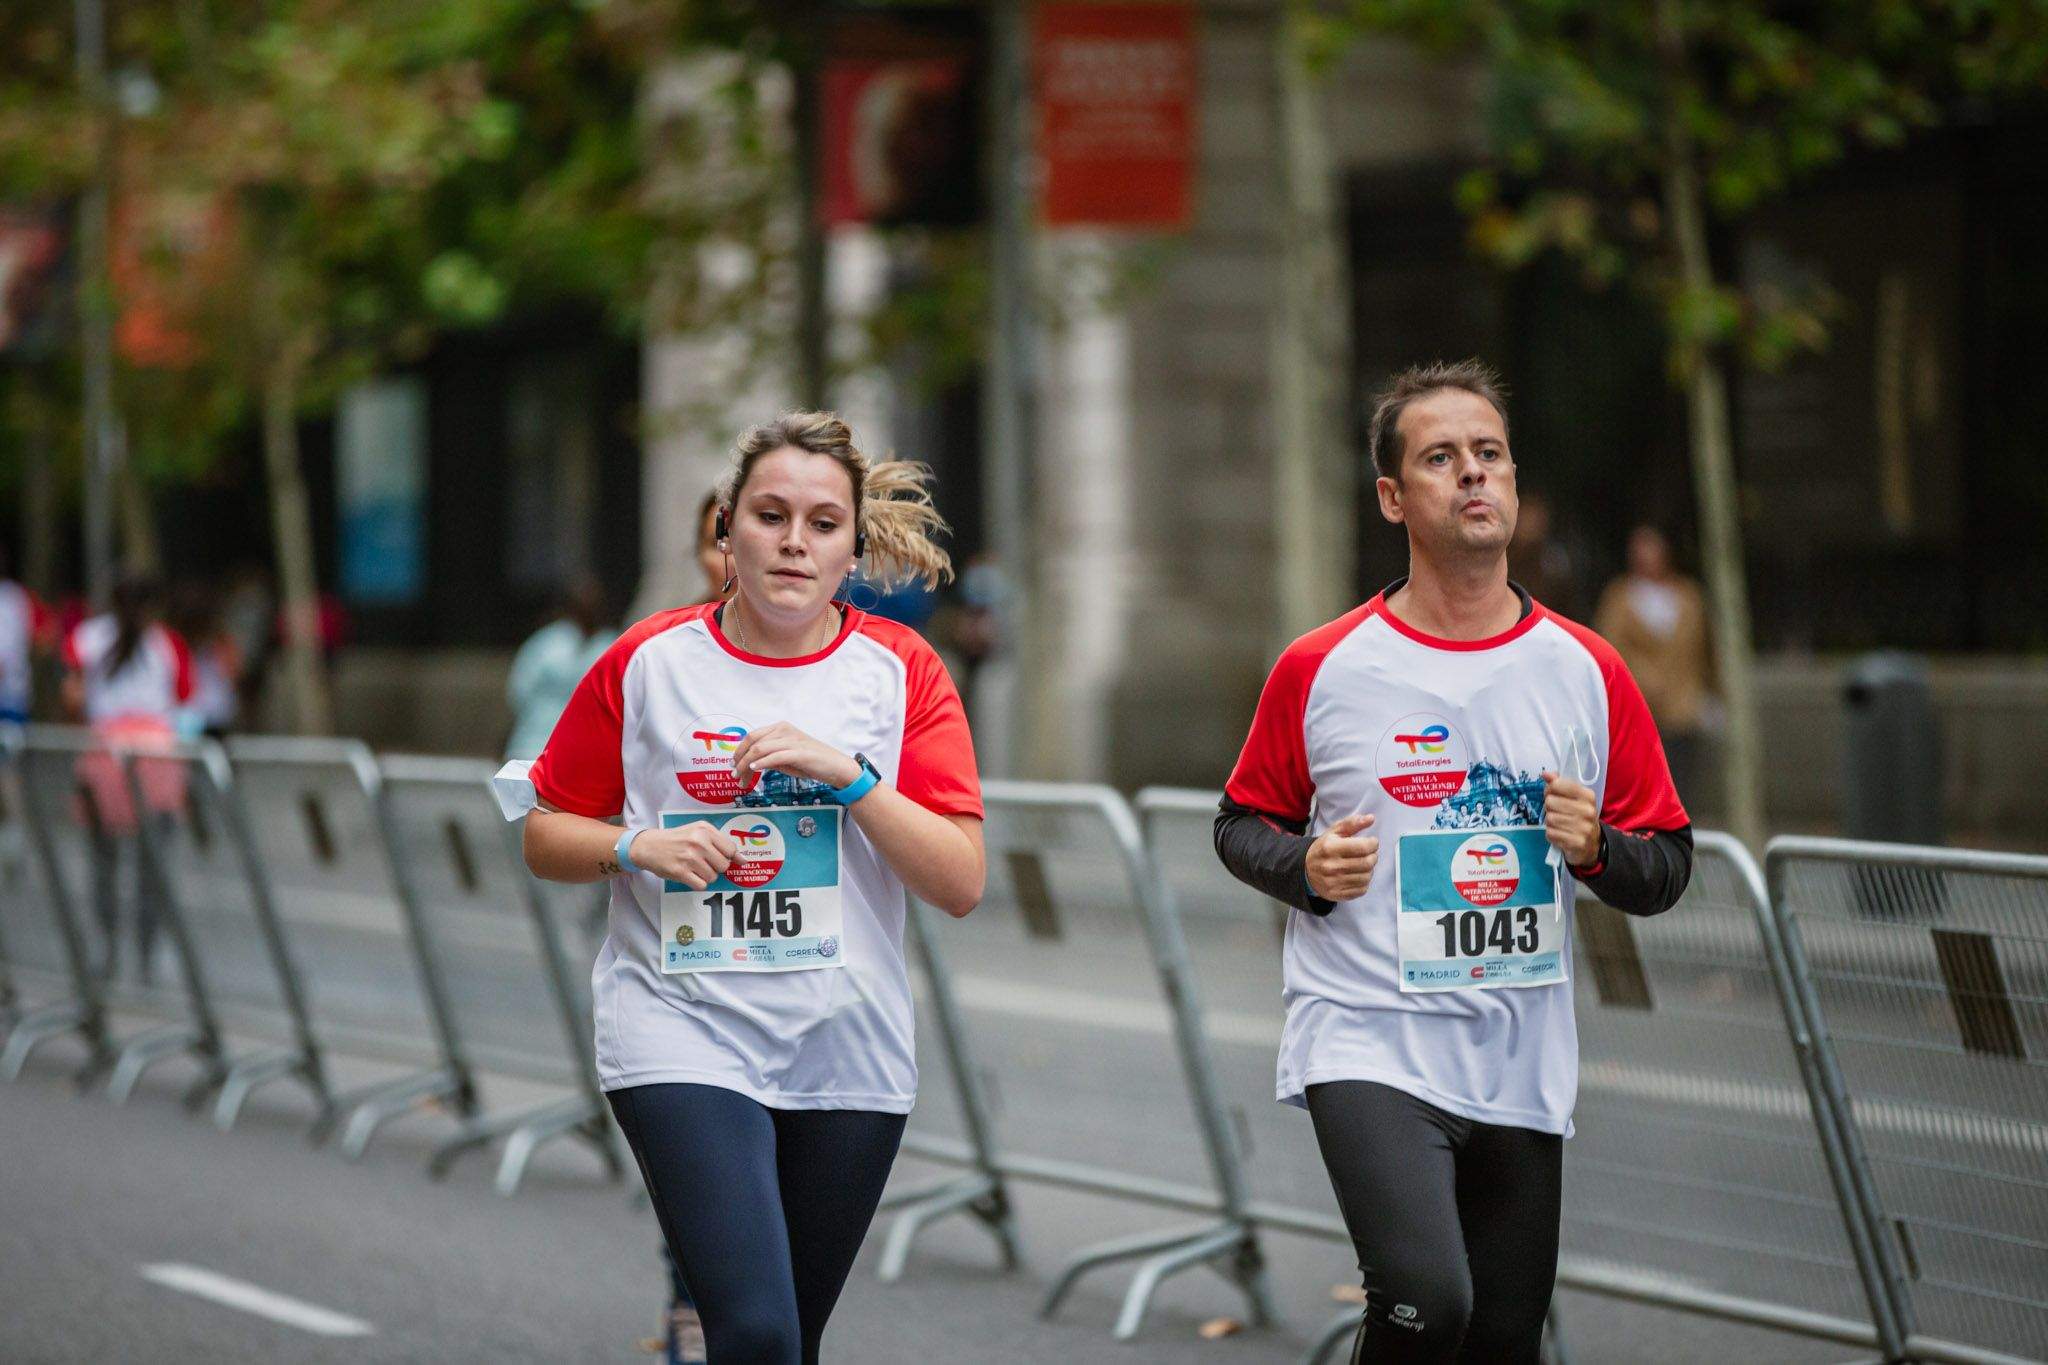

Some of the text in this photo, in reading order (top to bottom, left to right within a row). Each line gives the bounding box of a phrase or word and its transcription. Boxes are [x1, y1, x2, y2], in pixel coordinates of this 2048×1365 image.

[692, 757, 732, 765] TotalEner
[1396, 757, 1452, 768] TotalEnergies
[704, 773, 731, 781] MILLA
[1411, 774, 1437, 784] MILLA
[686, 781, 740, 790] INTERNACION
[1392, 782, 1458, 795] INTERNACIONAL
[697, 790, 708, 798] DE
[1403, 792, 1415, 802] DE
[743, 875, 769, 883] MADRID
[1481, 893, 1506, 902] MADRID
[703, 890, 802, 938] 1145
[1436, 907, 1539, 958] 1043
[682, 950, 721, 960] MADRID
[785, 949, 820, 958] CORRED
[1420, 970, 1460, 980] MADRID
